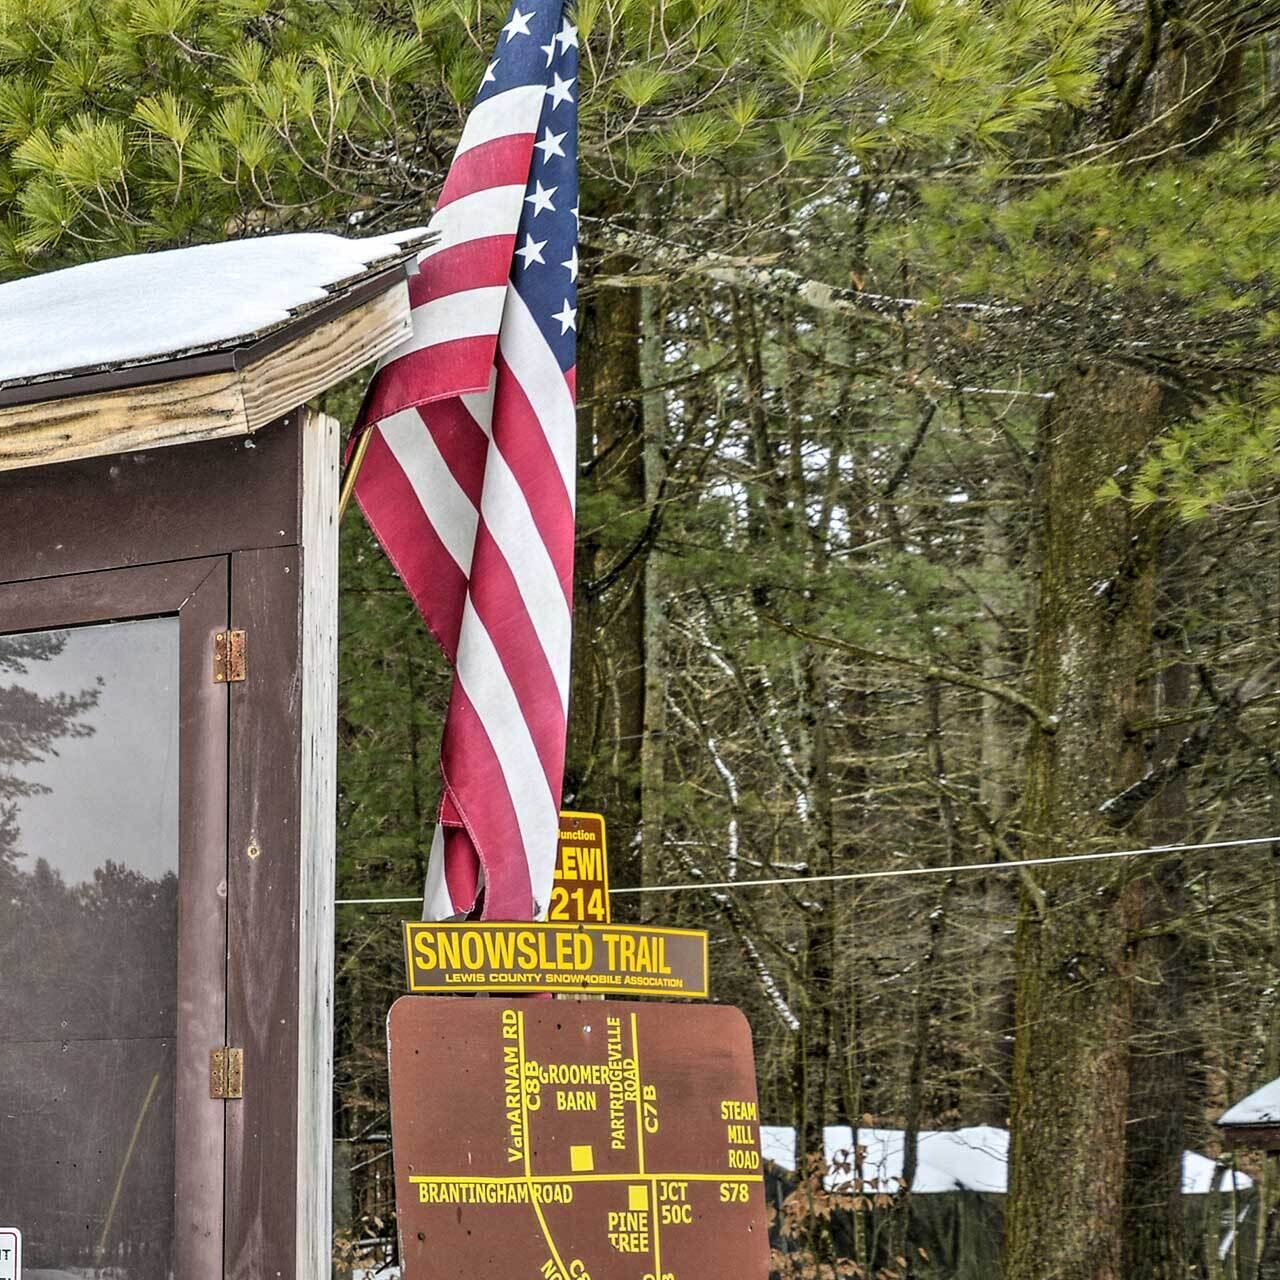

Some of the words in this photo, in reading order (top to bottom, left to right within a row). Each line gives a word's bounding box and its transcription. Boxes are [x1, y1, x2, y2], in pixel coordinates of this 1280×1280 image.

[556, 829, 596, 841] unction
[550, 886, 605, 921] 214
[414, 931, 593, 971] SNOWSLED
[602, 934, 672, 975] TRAIL
[445, 973, 486, 984] LEWIS
[488, 973, 543, 984] COUNTY
[545, 975, 623, 986] SNOWMOBILE
[624, 976, 684, 989] ASSOCIATION
[502, 1009, 519, 1041] RD
[539, 1064, 611, 1085] GROOMER
[606, 1016, 627, 1151] PARTRIDGEVILLE
[624, 1058, 640, 1103] ROAD
[525, 1060, 541, 1112] C8B
[503, 1044, 524, 1163] VanARNAM
[556, 1091, 597, 1112] BARN
[644, 1084, 659, 1134] C7B
[720, 1100, 758, 1122] STEAM
[727, 1124, 756, 1145] MILL
[728, 1149, 760, 1170] ROAD
[418, 1183, 528, 1204] BRANTINGHAM
[535, 1184, 574, 1204] ROAD
[659, 1181, 688, 1201] JCT
[719, 1183, 750, 1203] S78
[607, 1212, 649, 1232] PINE
[661, 1204, 693, 1225] 50C
[607, 1233, 649, 1253] TREE
